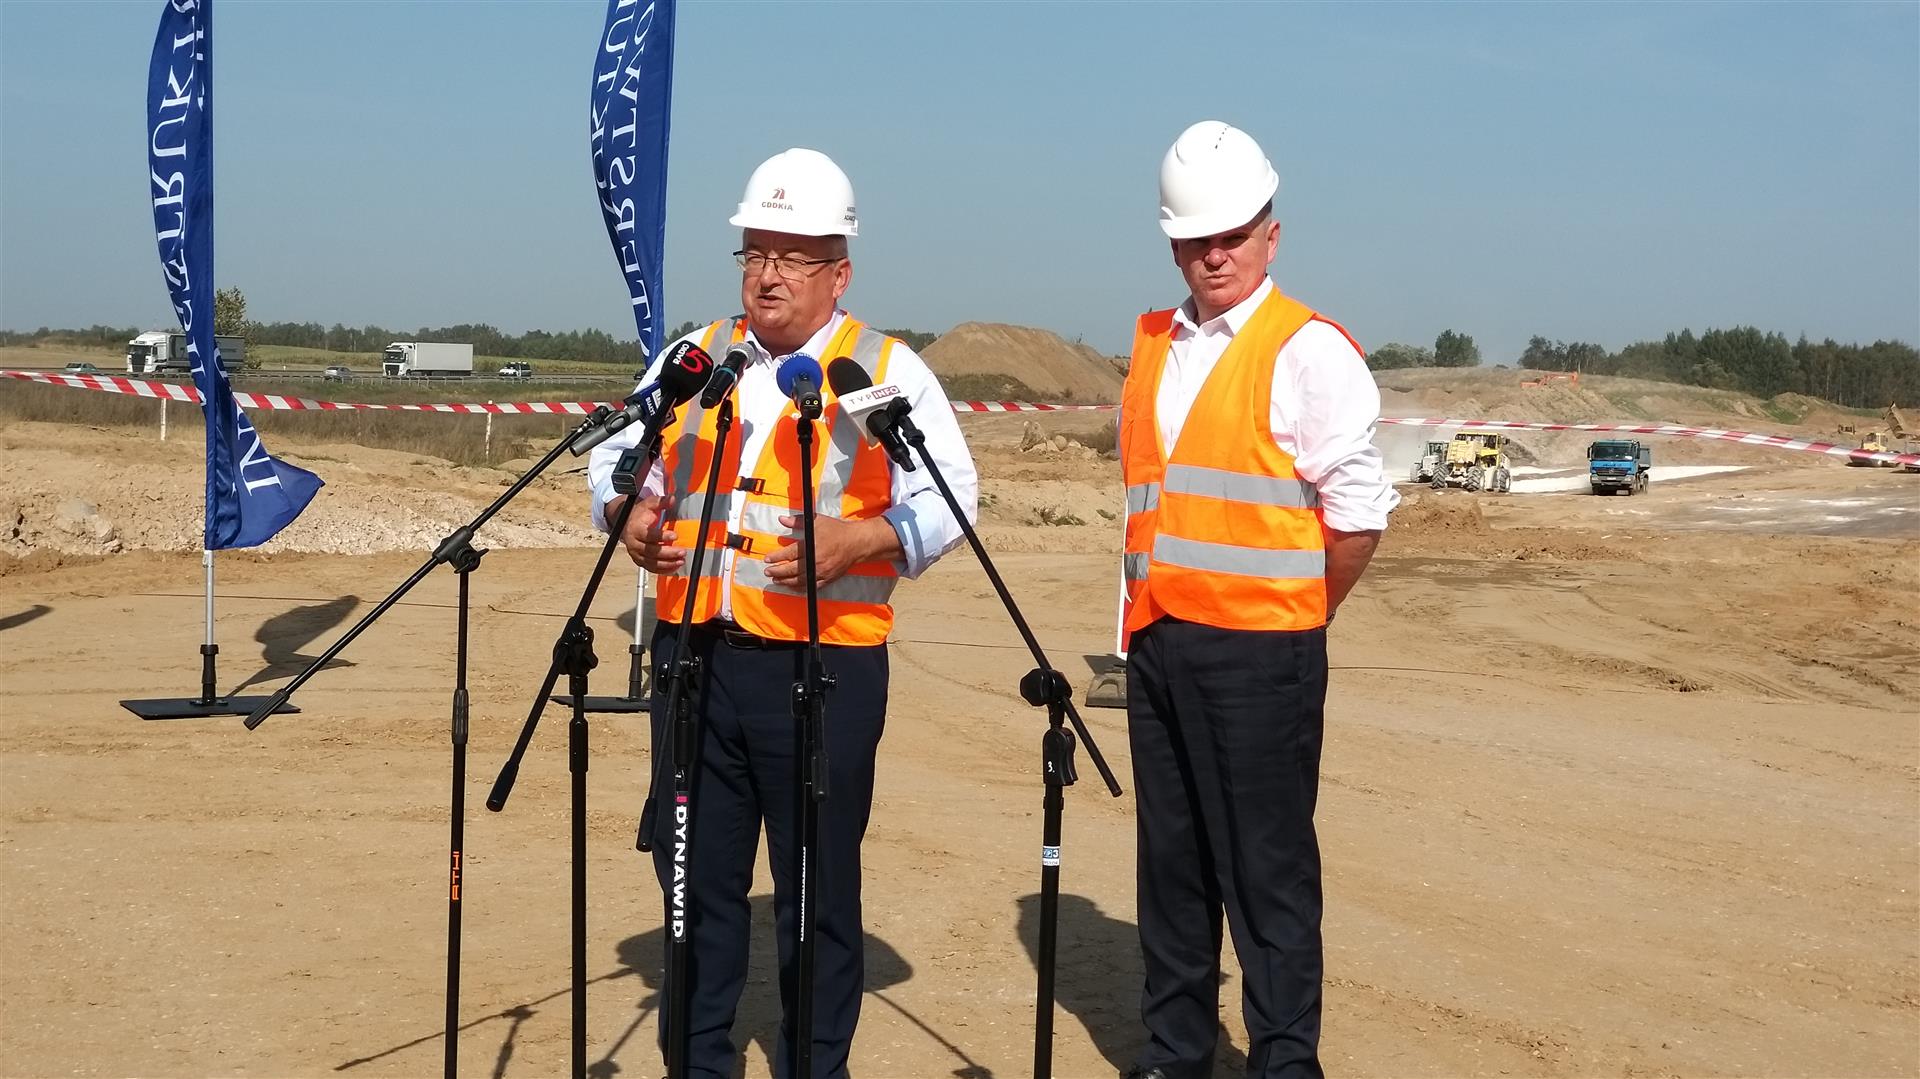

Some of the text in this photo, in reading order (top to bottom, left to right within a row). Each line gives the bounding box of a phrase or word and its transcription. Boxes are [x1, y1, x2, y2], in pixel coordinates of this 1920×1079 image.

[672, 343, 690, 365] RADIO
[849, 386, 900, 405] TVP INFO
[673, 805, 687, 938] DYNAWID
